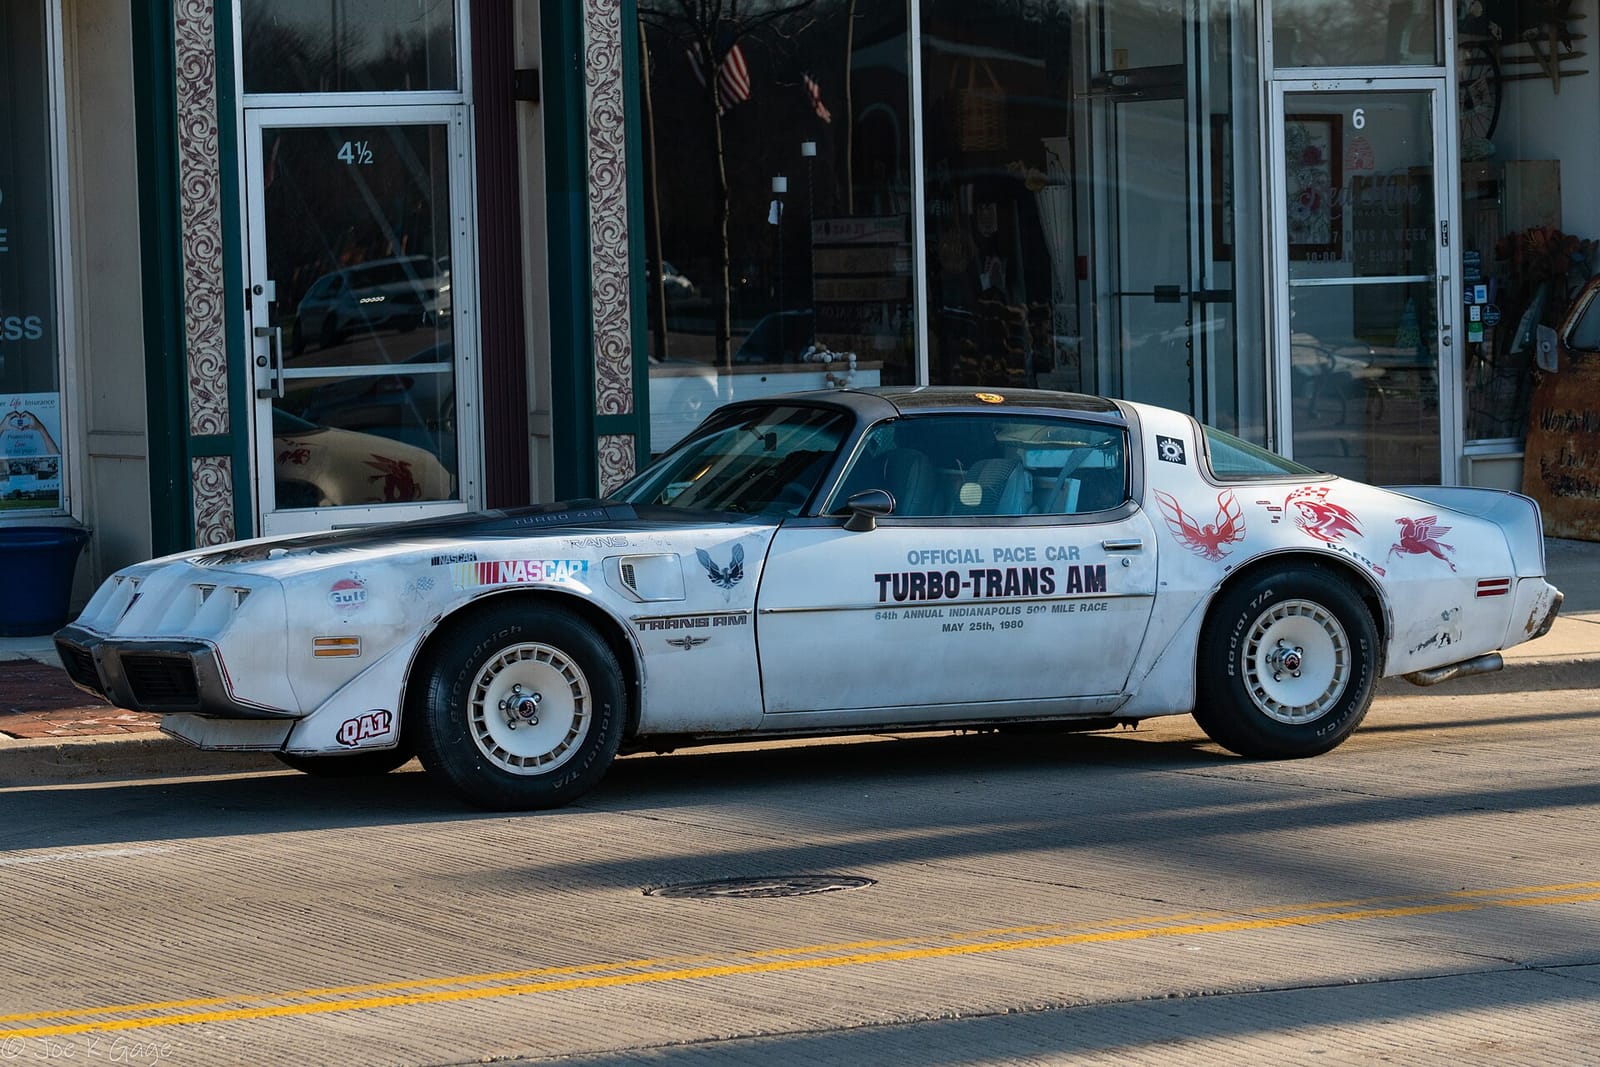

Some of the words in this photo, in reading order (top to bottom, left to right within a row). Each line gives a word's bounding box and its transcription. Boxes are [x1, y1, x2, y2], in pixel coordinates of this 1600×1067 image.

[1352, 108, 1366, 129] 6
[0, 316, 43, 341] SS
[907, 548, 984, 566] OFFICIAL
[993, 546, 1036, 563] PACE
[1045, 545, 1080, 562] CAR
[874, 565, 1056, 603] TURBO-TRANS
[1066, 563, 1107, 594] AM
[874, 611, 898, 621] 64th
[903, 608, 944, 619] ANNUAL
[948, 605, 1021, 618] INDIANAPOLIS
[1026, 604, 1047, 615] 500
[1051, 603, 1075, 614] MILE
[1079, 602, 1108, 613] RACE
[635, 617, 710, 632] TRANS
[713, 614, 748, 627] AM
[942, 622, 964, 633] MAY
[969, 620, 995, 633] 25th,
[999, 619, 1023, 631] 1980
[1227, 611, 1248, 677] Radial
[1249, 588, 1274, 609] T/A
[341, 711, 391, 746] QA1
